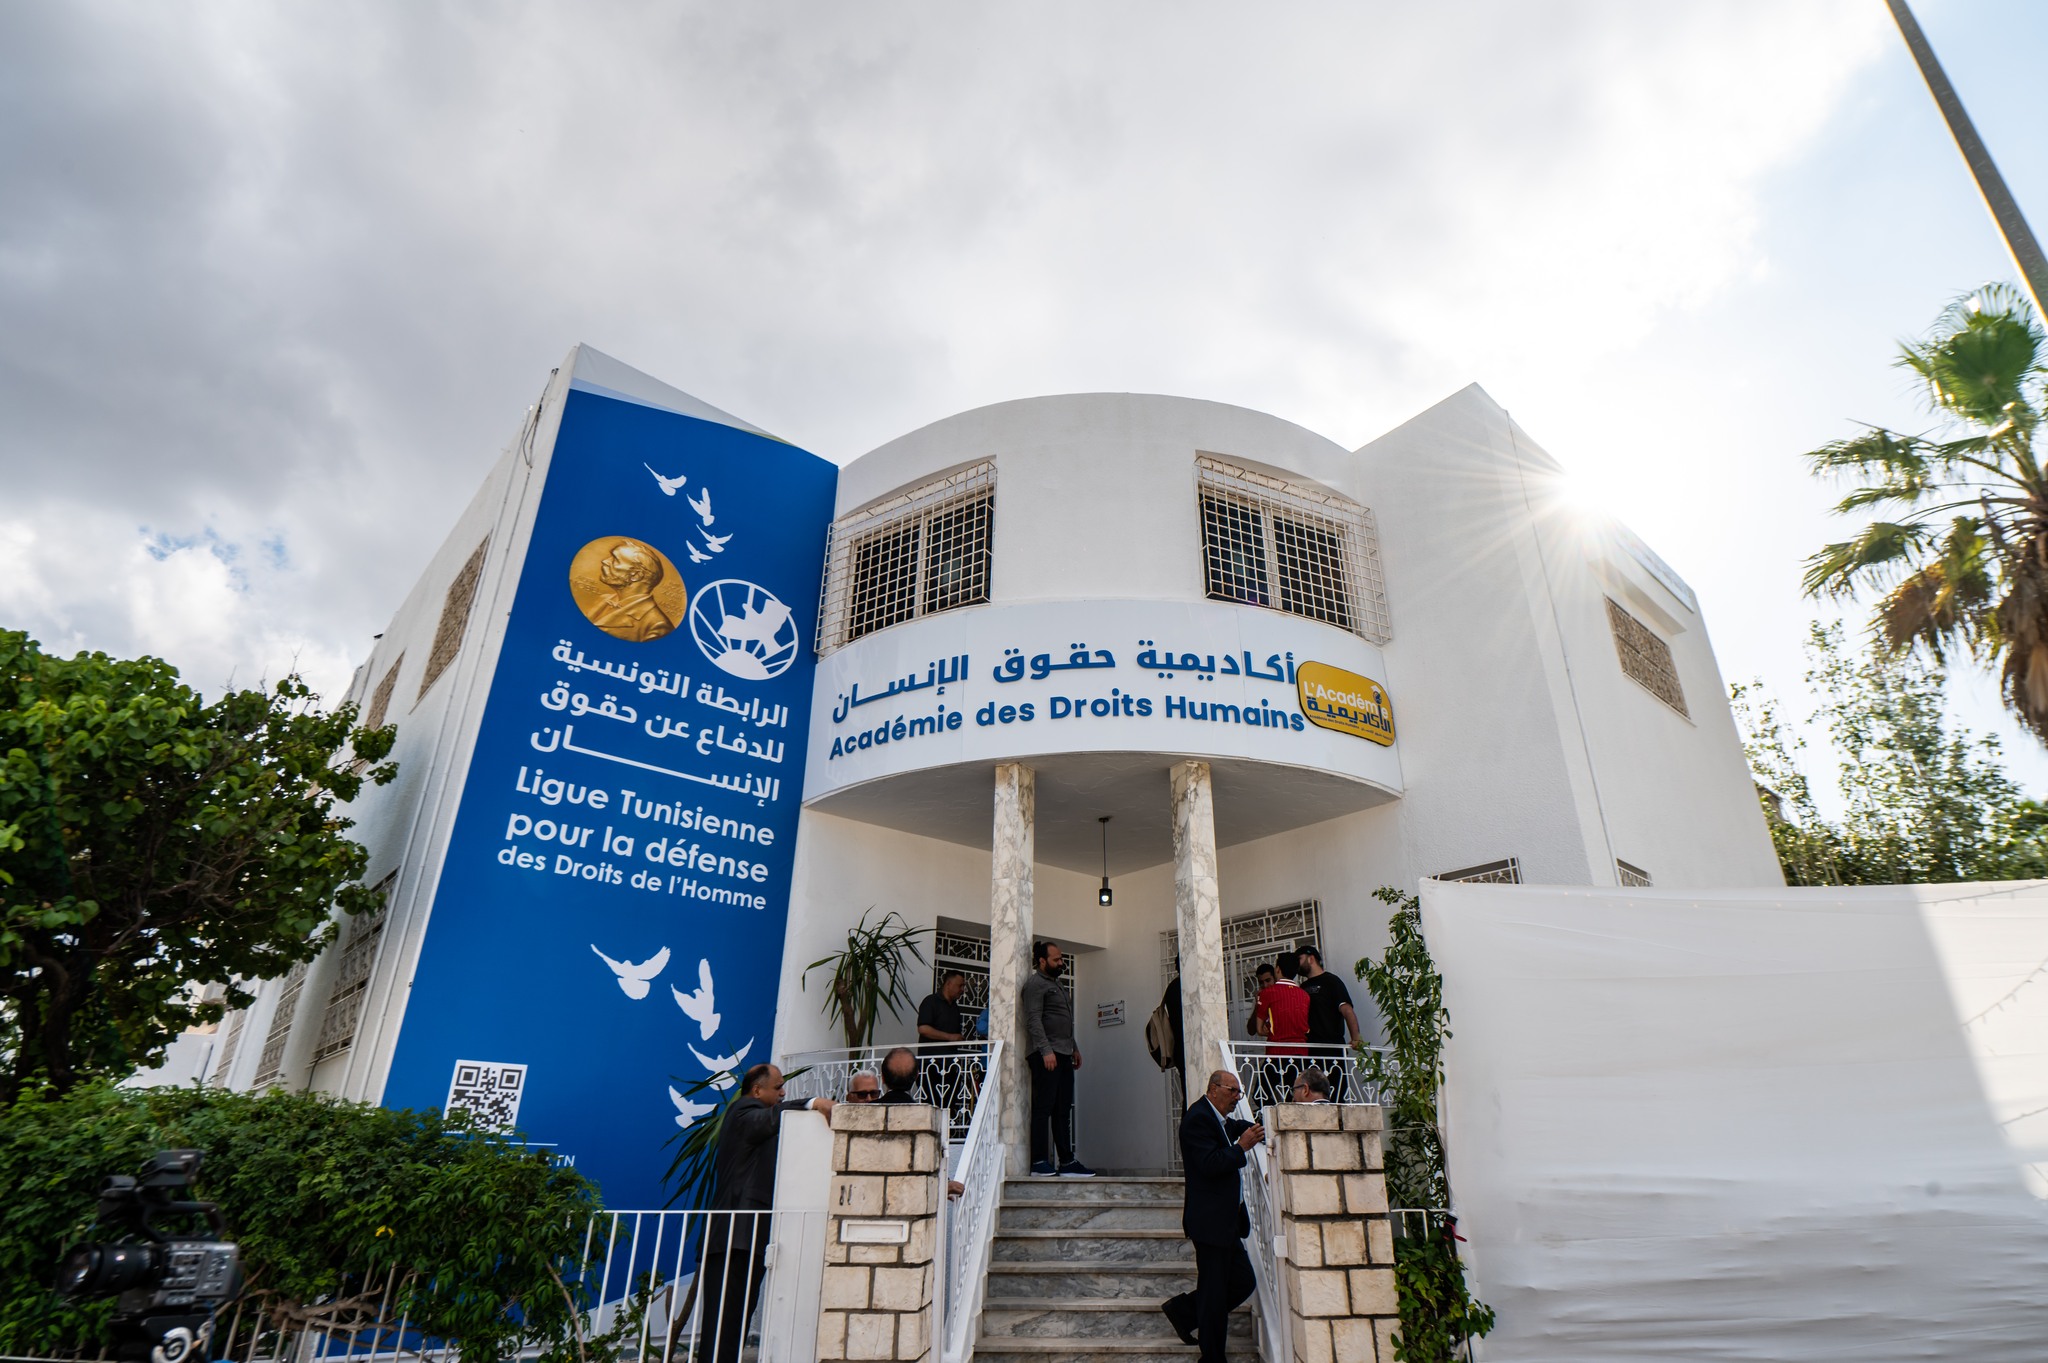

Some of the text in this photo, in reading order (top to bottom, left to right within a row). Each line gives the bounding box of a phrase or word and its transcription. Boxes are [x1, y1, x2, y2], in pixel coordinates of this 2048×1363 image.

[540, 680, 784, 763] للدفاع عن حقوق
[552, 639, 788, 728] الرابطة التونسية
[833, 639, 1296, 724] أكاديمية حقوق الإنسان
[829, 688, 1305, 760] Académie des Droits Humains
[515, 765, 775, 846] Ligue Tunisienne
[497, 845, 767, 910] des Droits de l’Homme
[505, 813, 769, 883] pour la défense
